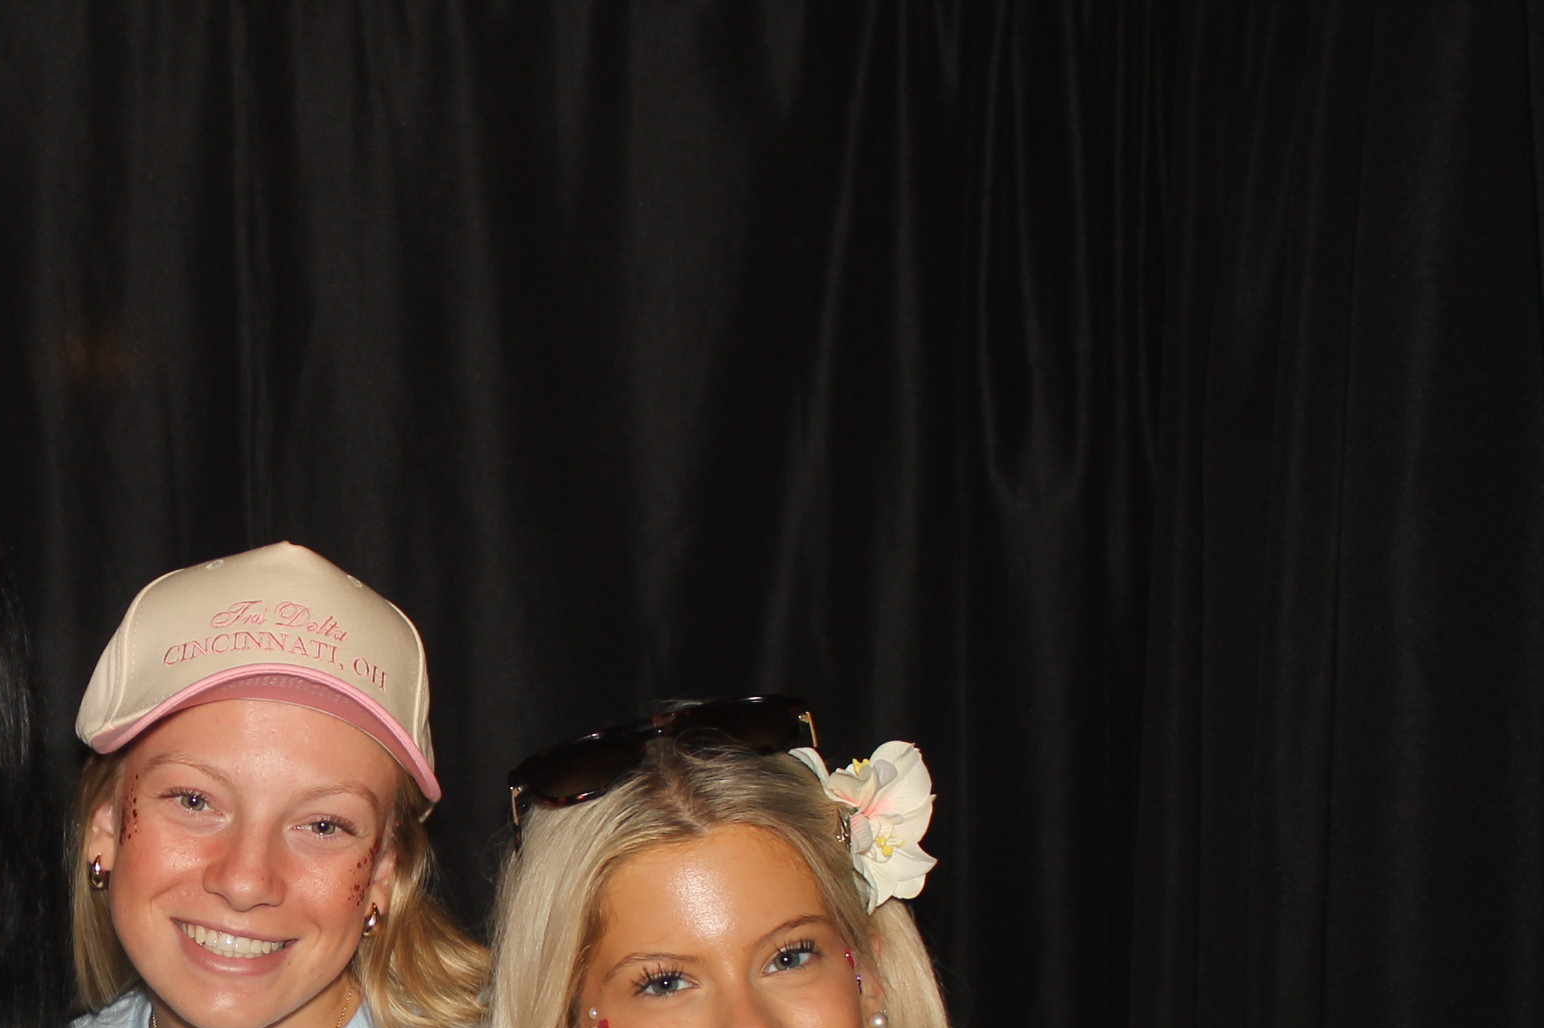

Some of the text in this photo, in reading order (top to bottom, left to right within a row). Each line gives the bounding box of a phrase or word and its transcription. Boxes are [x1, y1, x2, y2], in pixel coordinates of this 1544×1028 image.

[210, 600, 348, 642] Tri Delta
[163, 631, 387, 691] CINCINNATI, OH
